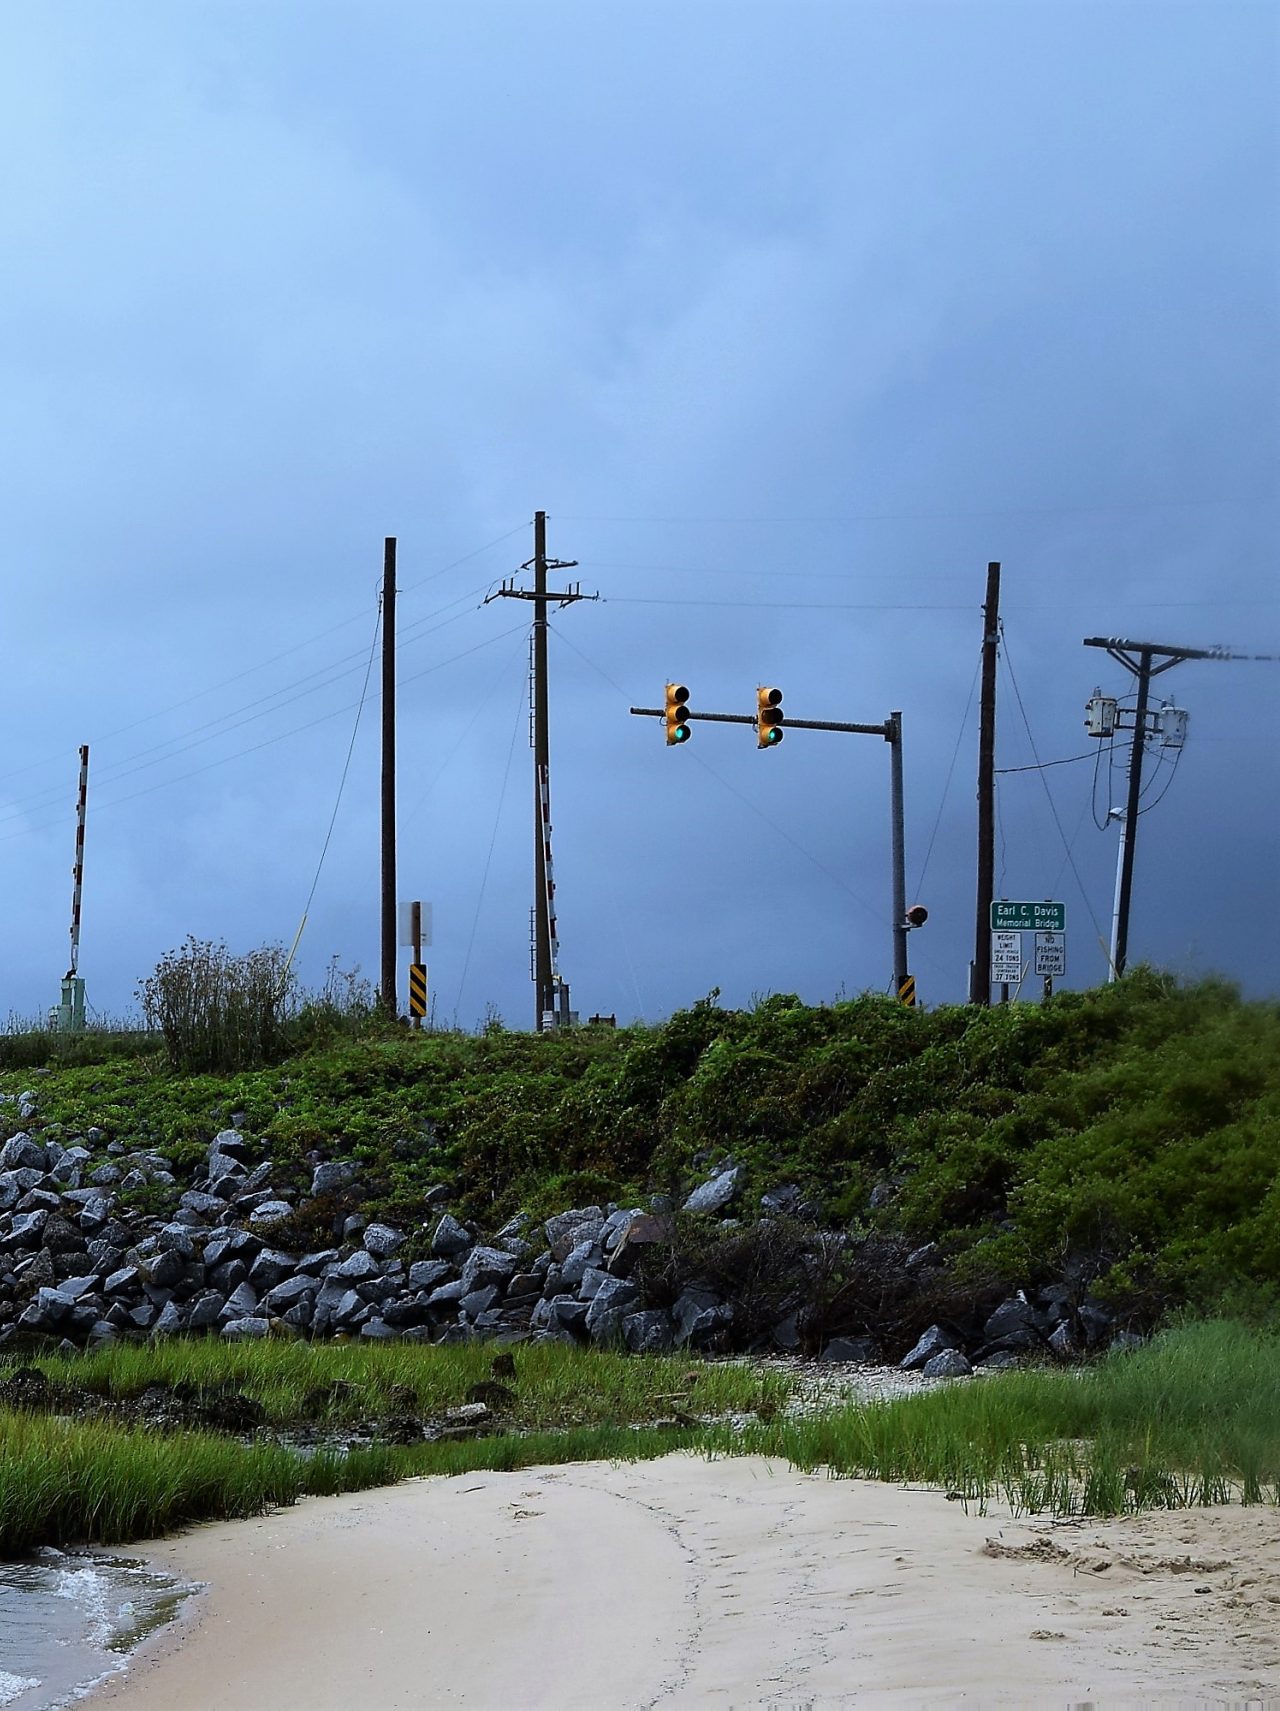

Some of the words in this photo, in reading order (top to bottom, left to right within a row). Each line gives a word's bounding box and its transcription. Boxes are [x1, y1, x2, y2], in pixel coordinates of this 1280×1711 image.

[998, 905, 1015, 915] Earl
[1020, 905, 1029, 915] C.
[1034, 906, 1058, 916] Davis
[996, 919, 1031, 927] Memorial
[1035, 919, 1059, 930] Bridge
[1038, 964, 1062, 972] BRIDGE
